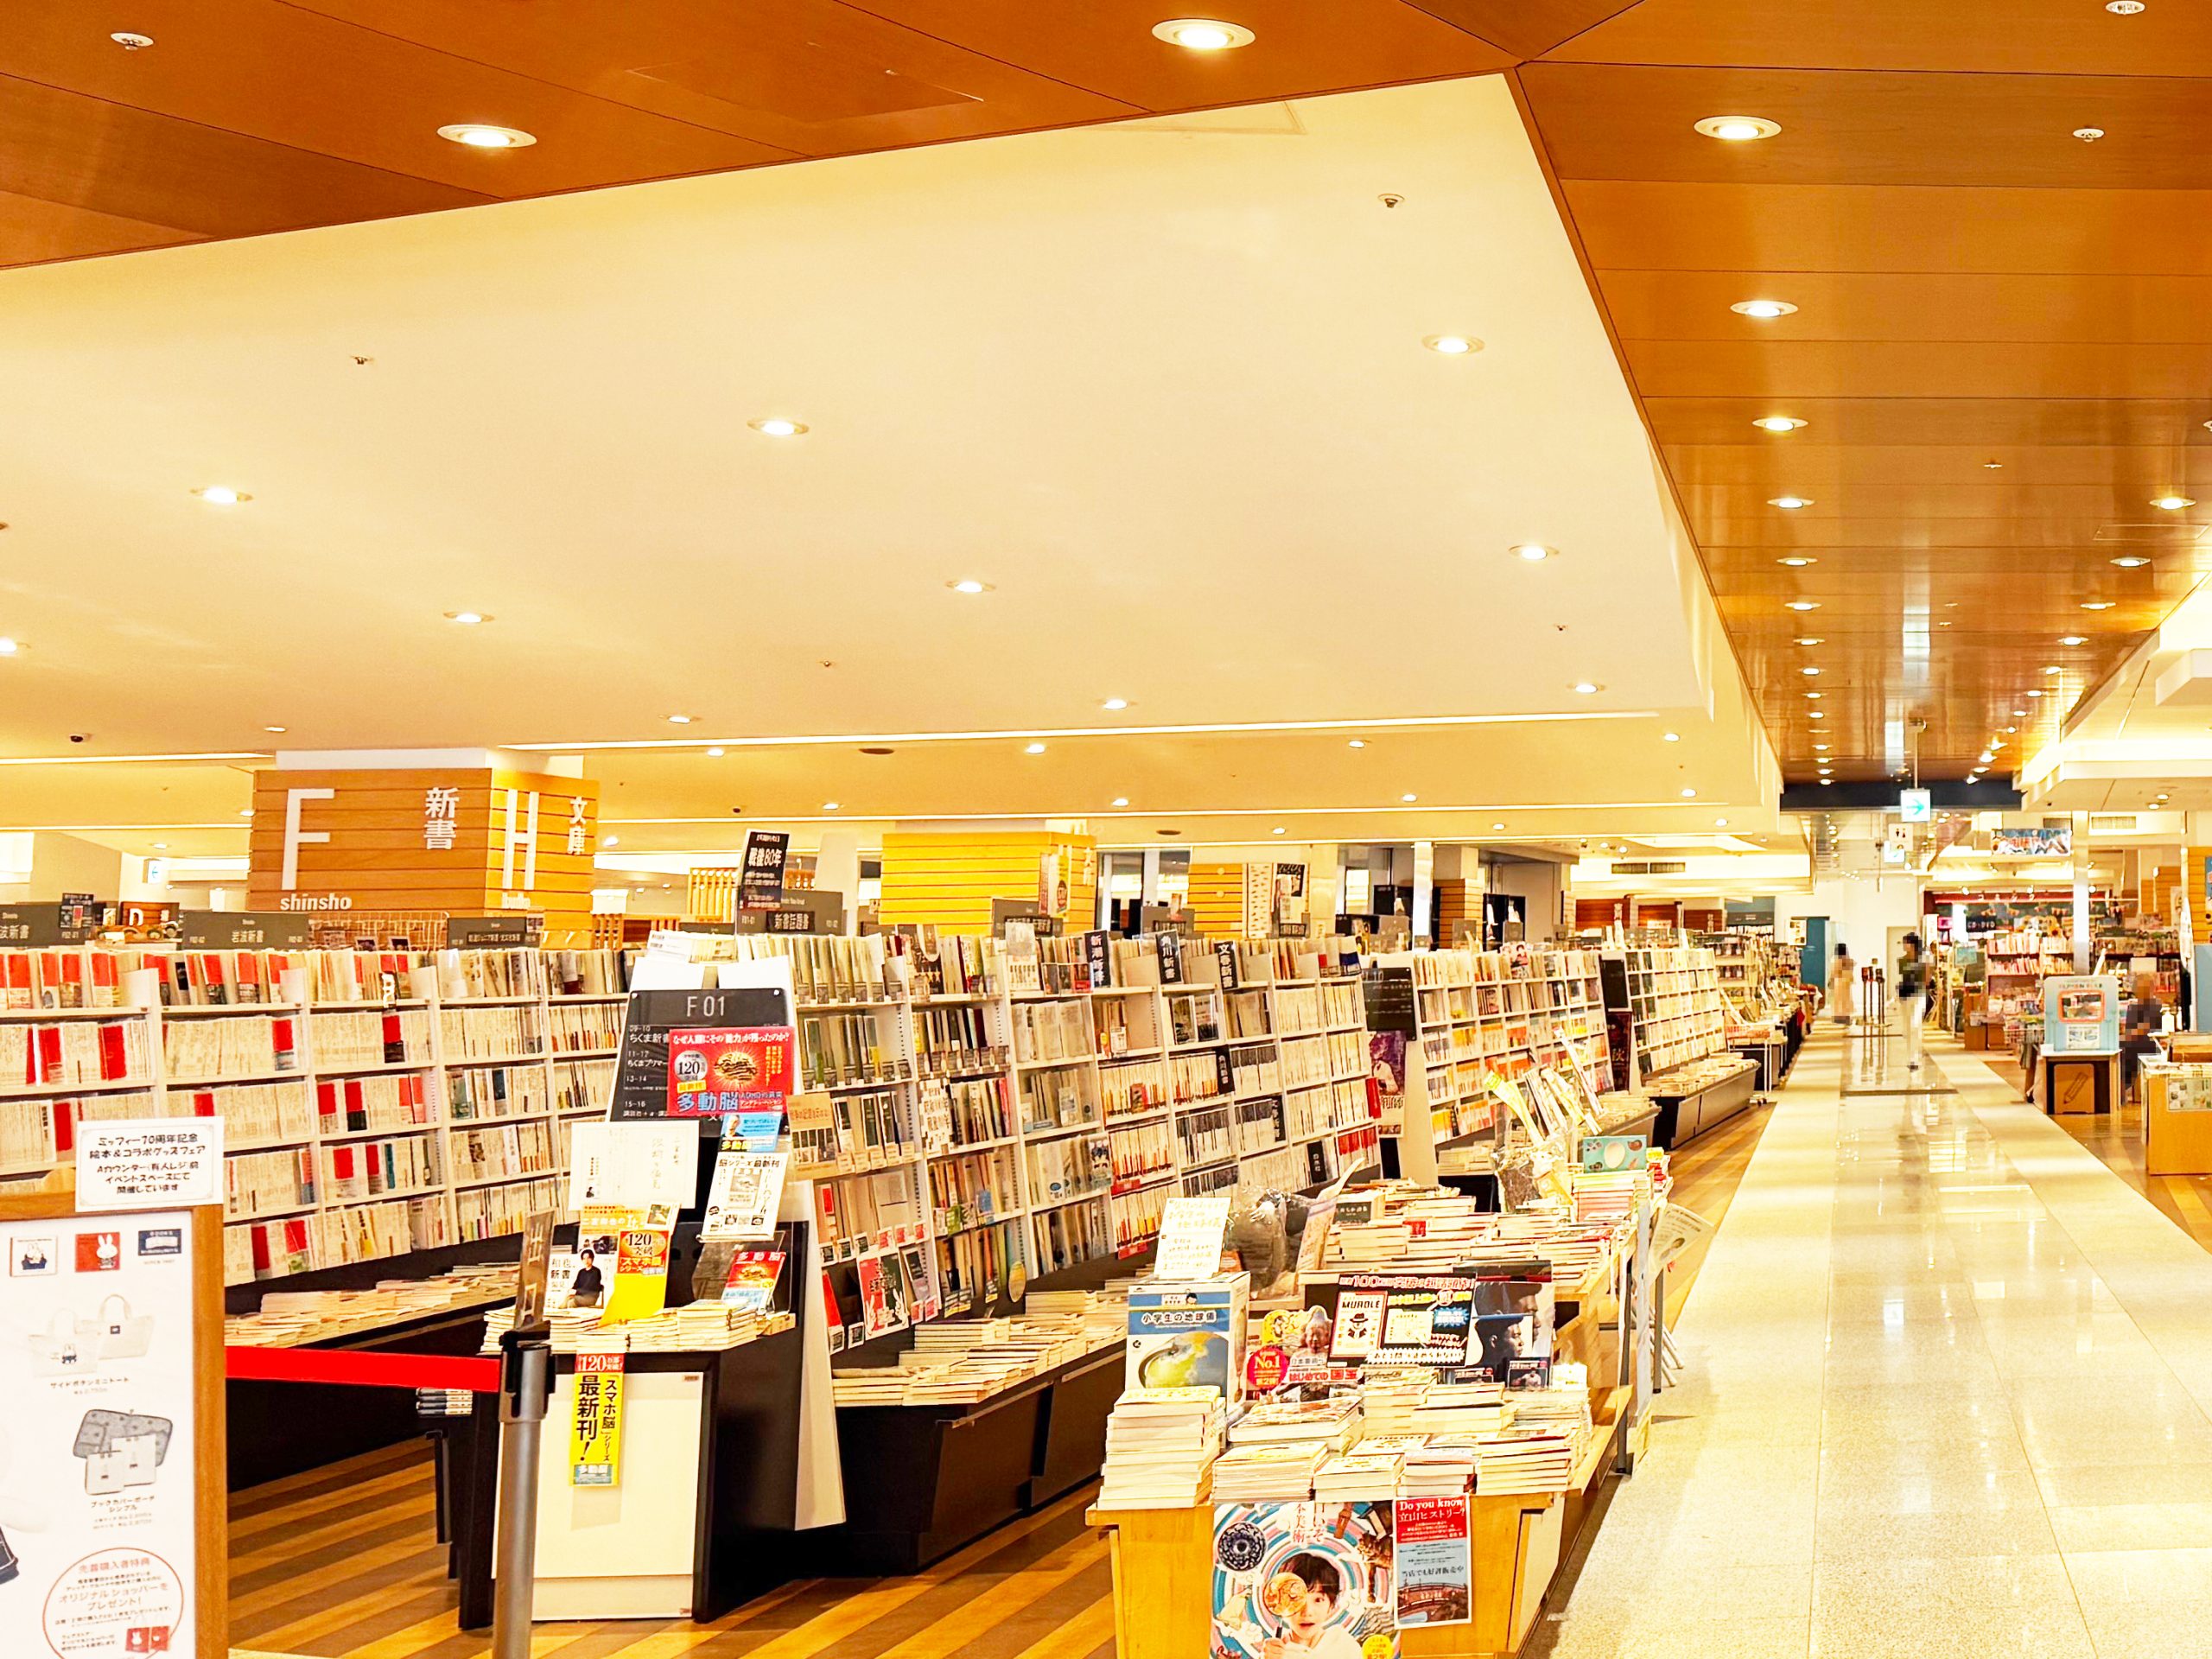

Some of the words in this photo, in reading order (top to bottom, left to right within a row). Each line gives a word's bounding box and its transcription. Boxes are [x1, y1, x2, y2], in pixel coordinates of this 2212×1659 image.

[423, 786, 460, 850] 新書
[567, 796, 588, 855] 文庫
[281, 788, 335, 891] F
[502, 788, 540, 891] H
[280, 893, 353, 912] shinsho
[678, 1061, 701, 1075] 120
[677, 1091, 739, 1112] 多動脳
[98, 1133, 198, 1147] ミッフィー70周年記念
[117, 1184, 179, 1194] 開催しています
[628, 1233, 652, 1246] 120
[1142, 1311, 1216, 1325] 小学生の地球儀
[582, 1355, 606, 1371] 120
[1255, 1356, 1281, 1369] No.1
[576, 1375, 601, 1461] 最新刊!
[1400, 1502, 1414, 1511] Do
[1416, 1501, 1434, 1511] you
[1437, 1498, 1464, 1508] know
[1399, 1507, 1465, 1522] 立山ヒストリー?
[87, 1597, 141, 1611] プレゼント!
